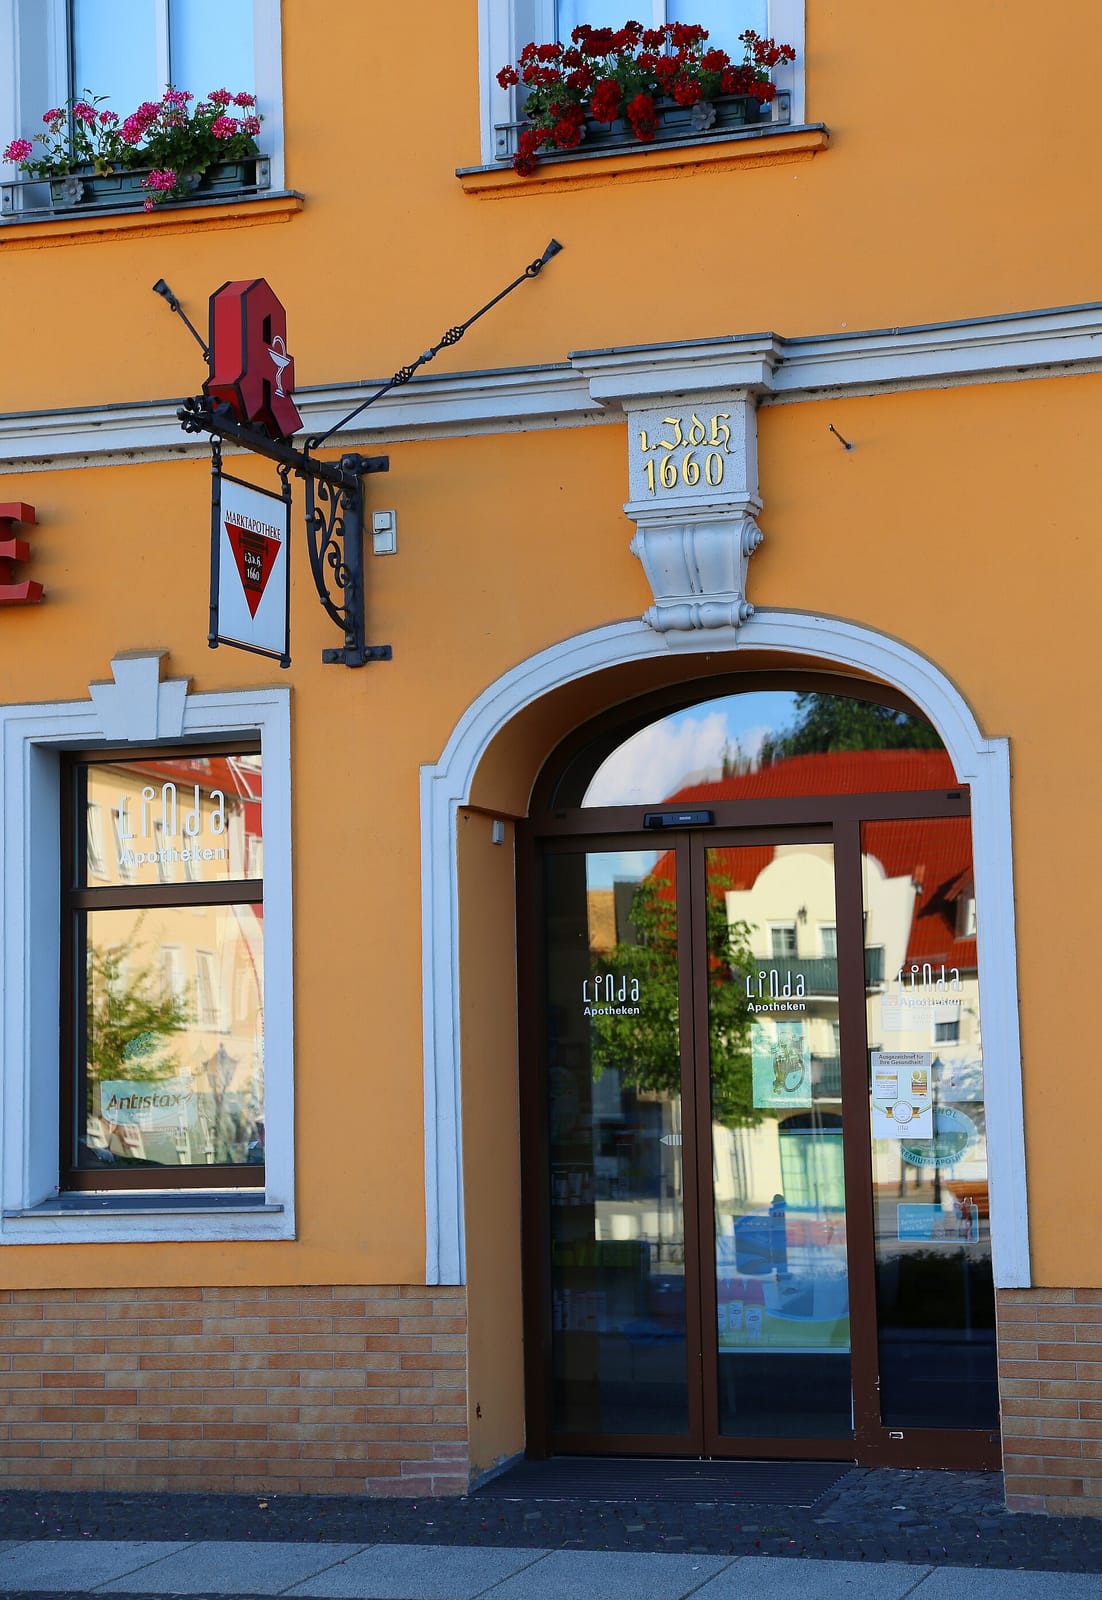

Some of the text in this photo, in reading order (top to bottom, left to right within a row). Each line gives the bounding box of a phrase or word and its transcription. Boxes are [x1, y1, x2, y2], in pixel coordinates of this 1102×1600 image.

[643, 451, 724, 496] 1660
[225, 509, 281, 541] MARKTAPOTHEKE
[247, 567, 260, 581] 1660
[120, 847, 225, 867] Apotheken
[583, 1006, 640, 1017] Apotheken
[747, 1002, 806, 1013] Apotheken
[106, 1093, 181, 1111] Antistax
